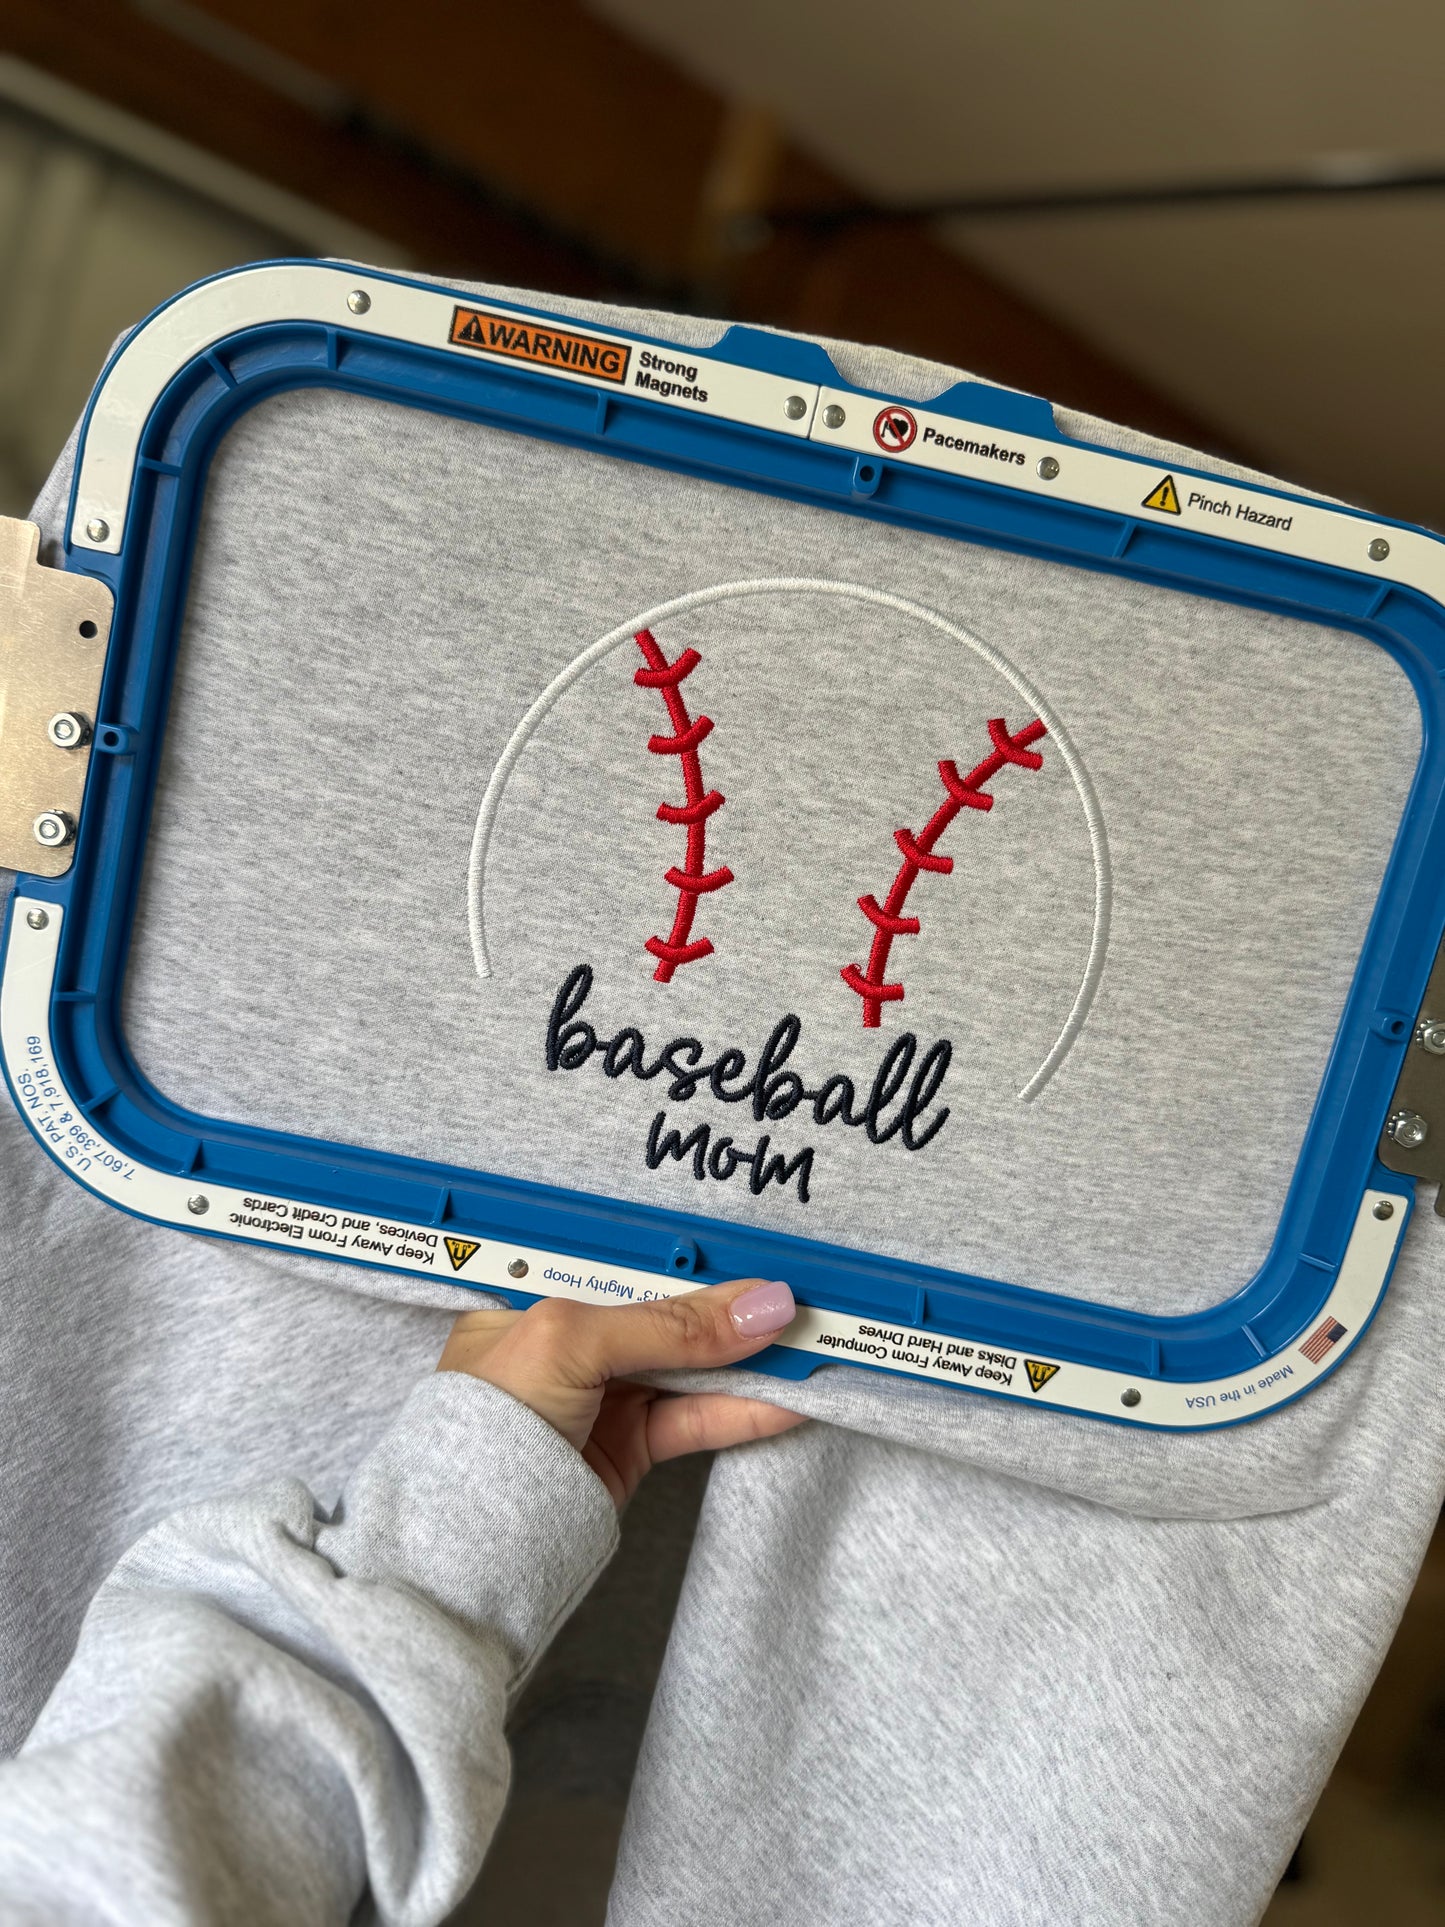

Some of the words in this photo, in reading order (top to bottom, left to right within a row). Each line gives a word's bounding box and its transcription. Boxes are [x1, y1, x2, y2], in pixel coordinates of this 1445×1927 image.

[488, 322, 620, 375] WARNING
[639, 351, 698, 382] Strong
[634, 371, 709, 403] Magnets
[922, 426, 1026, 466] Pacemakers
[1187, 493, 1231, 518] Pinch
[1235, 504, 1293, 532] Hazard
[545, 963, 952, 1151] baseball
[27, 1036, 64, 1111] 7,918,169
[18, 1068, 43, 1109] NOS.
[37, 1110, 66, 1143] PAT.
[59, 1111, 73, 1124] &
[65, 1141, 92, 1171] U.S.
[69, 1125, 136, 1180] 7,607,399
[646, 1111, 815, 1203] mom
[243, 1197, 288, 1218] Cards
[292, 1206, 338, 1227] Credit
[229, 1212, 304, 1240] Electronic
[341, 1217, 371, 1231] and
[375, 1222, 439, 1248] Devices,
[308, 1228, 348, 1248] From
[351, 1234, 394, 1256] Away
[395, 1243, 435, 1265] Keep
[543, 1267, 582, 1289] Hoop
[585, 1275, 634, 1299] Mighty
[858, 1324, 904, 1345] Drives
[907, 1335, 943, 1353] Hard
[816, 1333, 887, 1360] Computer
[946, 1343, 974, 1357] and
[891, 1349, 929, 1368] From
[932, 1356, 973, 1377] Away
[977, 1350, 1017, 1370] Disks
[975, 1367, 1013, 1386] Keep
[1258, 1364, 1294, 1389] Made
[1219, 1389, 1241, 1402] the
[1243, 1384, 1256, 1395] in
[1185, 1395, 1216, 1409] USA
